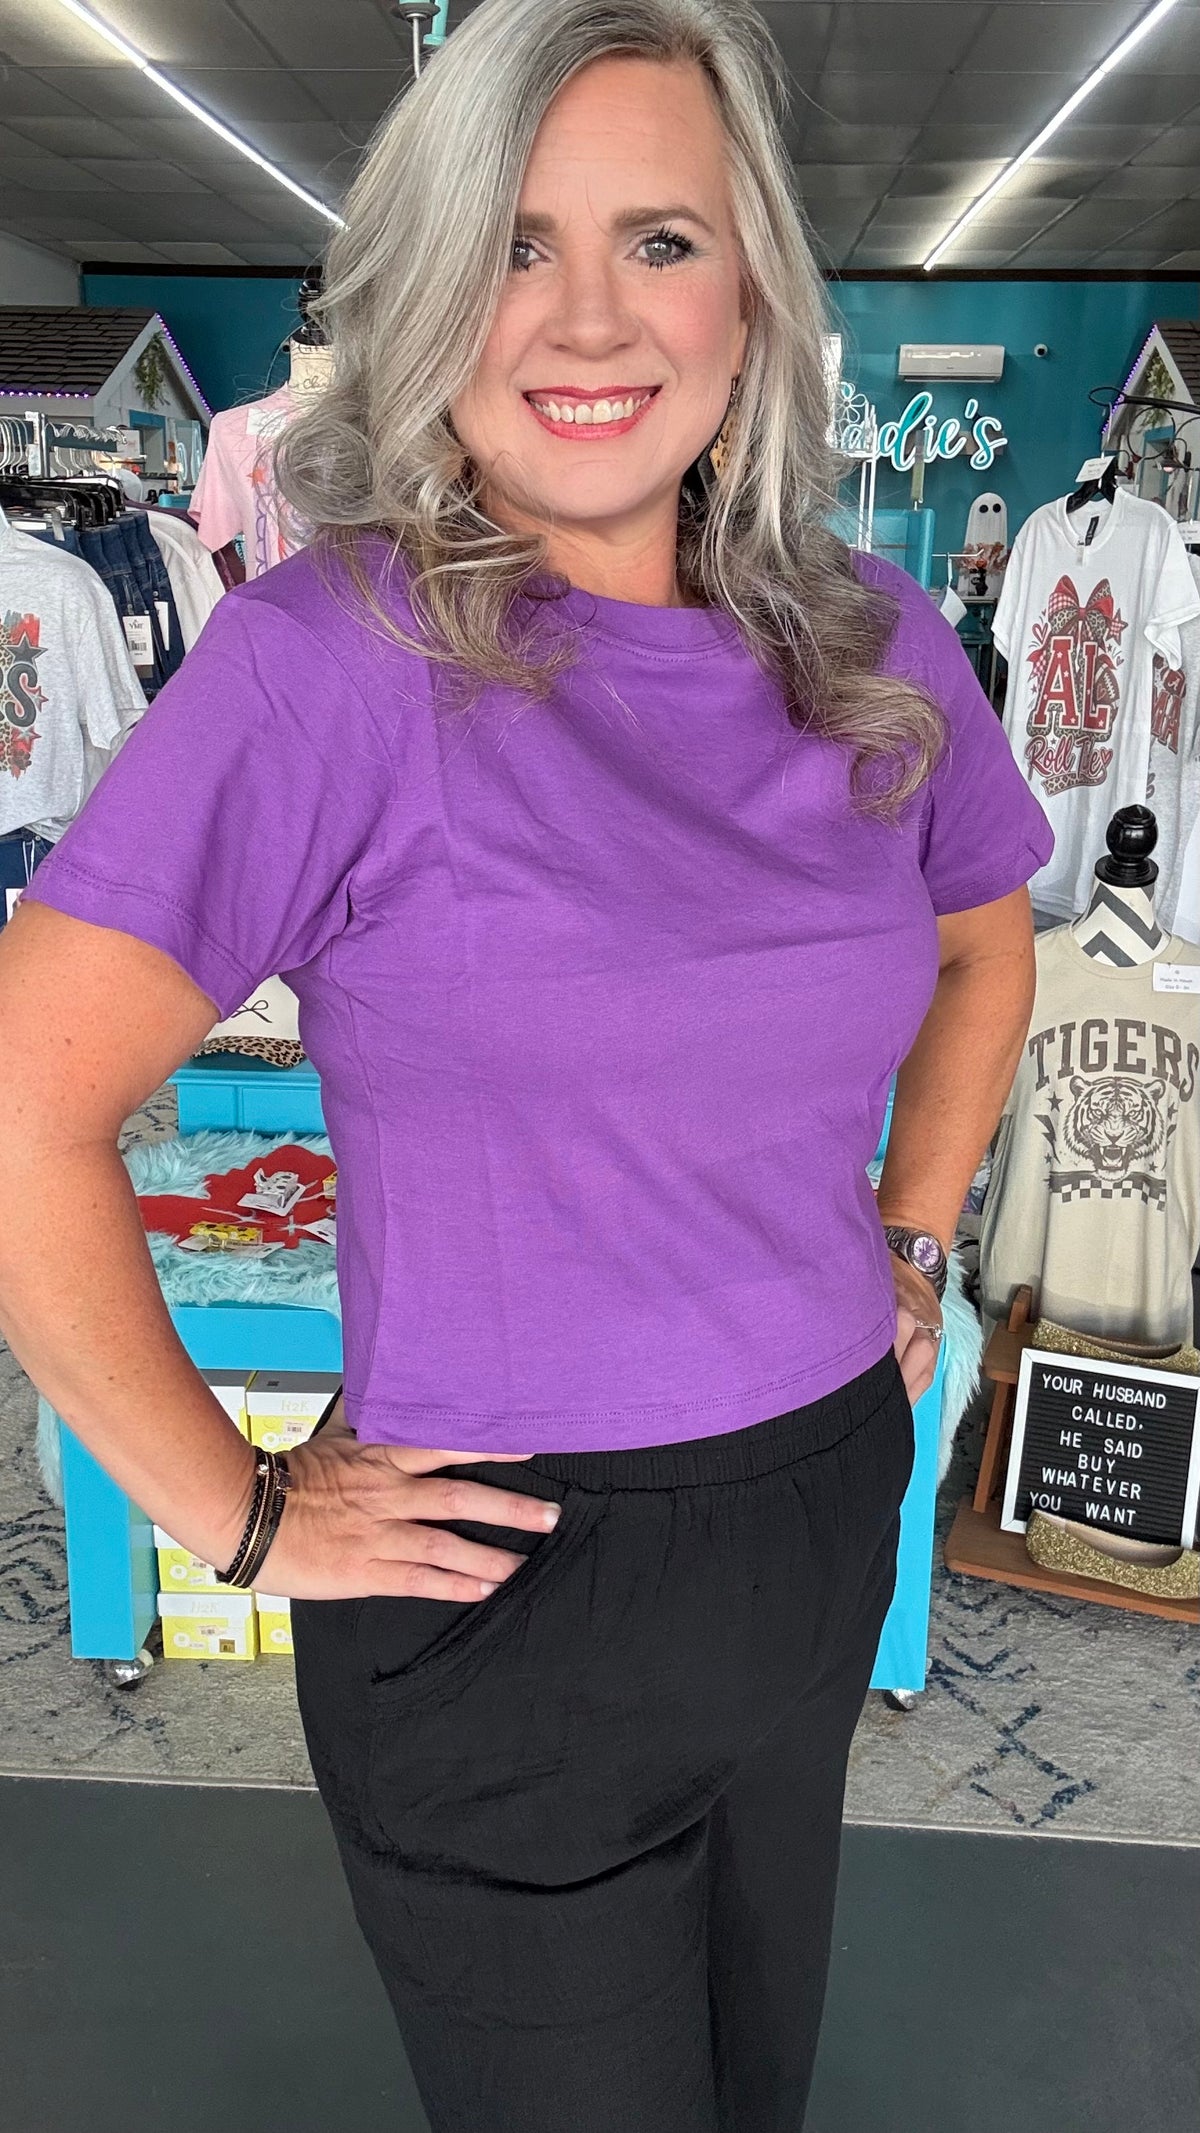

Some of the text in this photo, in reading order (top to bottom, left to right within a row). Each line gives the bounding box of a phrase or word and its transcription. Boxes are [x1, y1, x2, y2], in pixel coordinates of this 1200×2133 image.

[838, 391, 1008, 471] adie's
[1032, 636, 1111, 733] AL
[1024, 734, 1076, 781] Roll
[1028, 1018, 1200, 1102] TIGERS
[1042, 1373, 1167, 1409] YOUR HUSBAND
[1059, 1430, 1143, 1459] HE SAID
[1077, 1453, 1116, 1474] BUY
[1041, 1466, 1142, 1500] WHATEVER
[1029, 1491, 1137, 1526] YOU WANT
